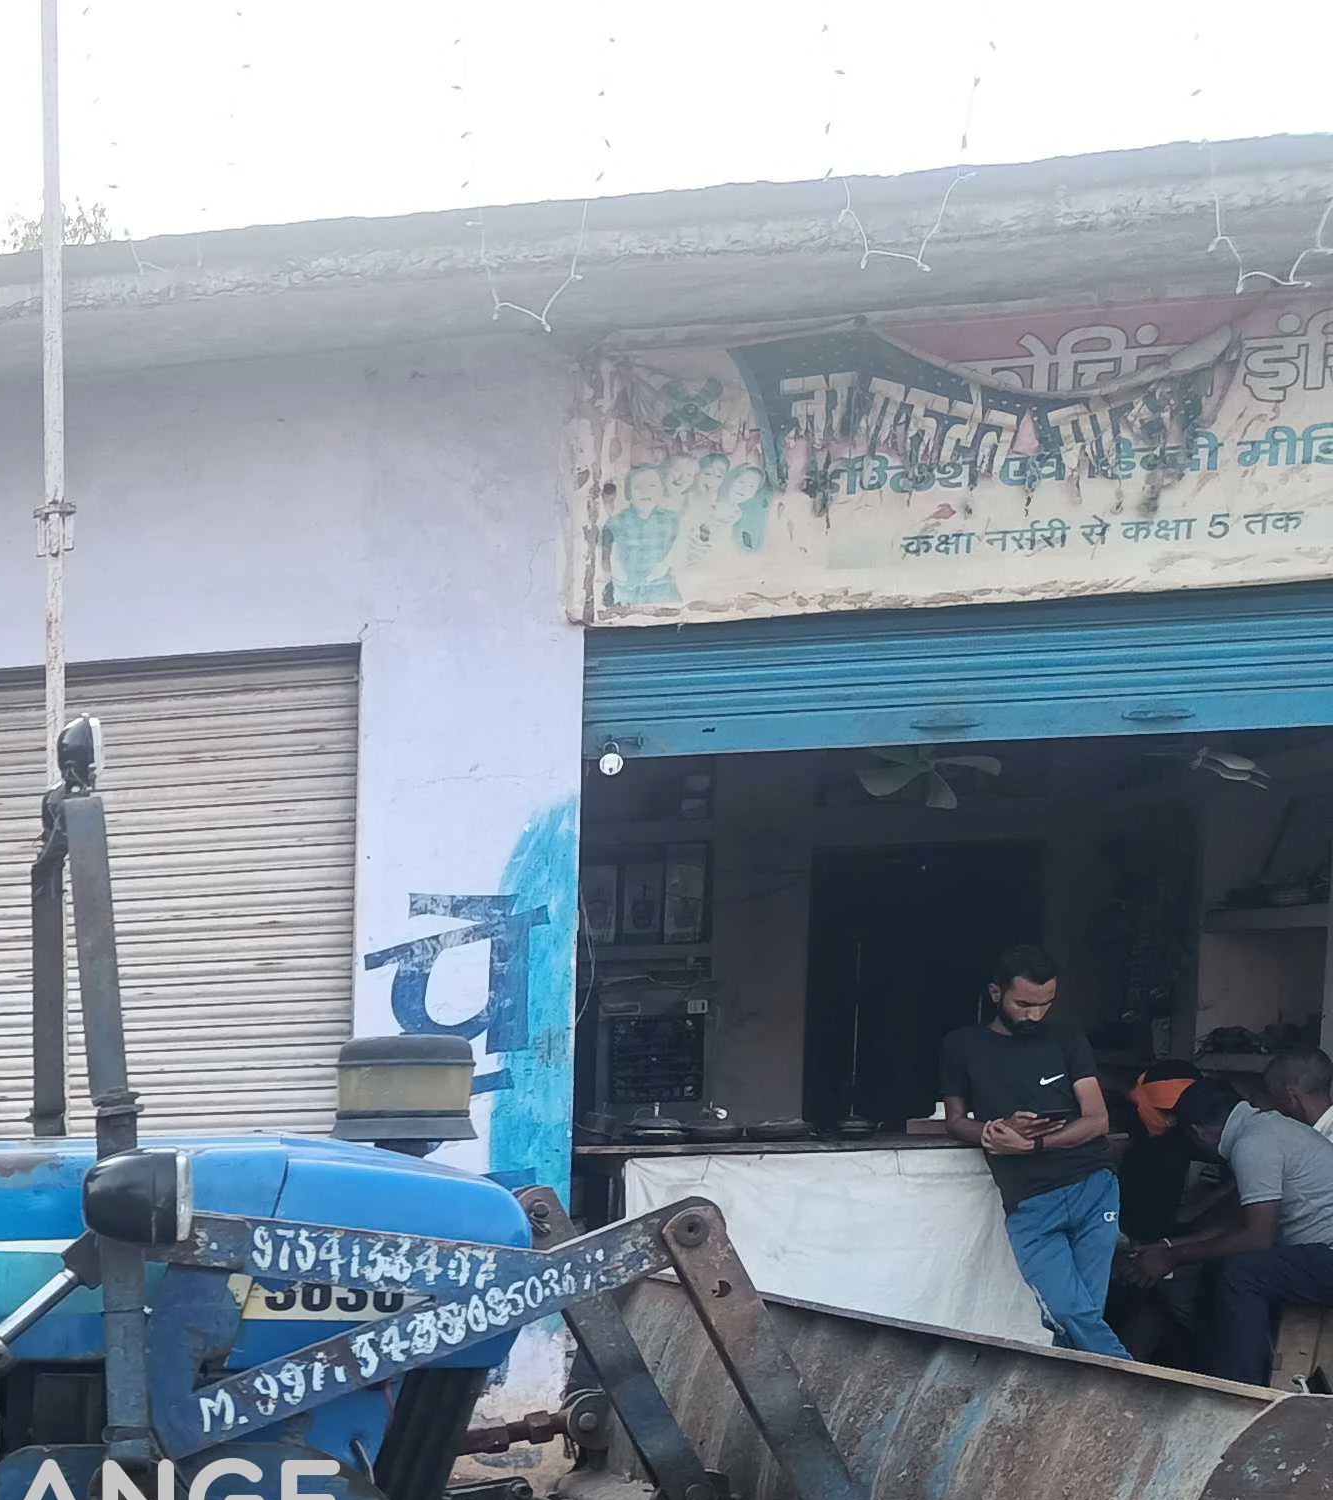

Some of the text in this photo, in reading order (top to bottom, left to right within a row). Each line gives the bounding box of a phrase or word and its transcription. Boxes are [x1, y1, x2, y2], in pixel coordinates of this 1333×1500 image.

[903, 509, 1306, 558] कक्षा नर्सरी से कक्षा 5 तक
